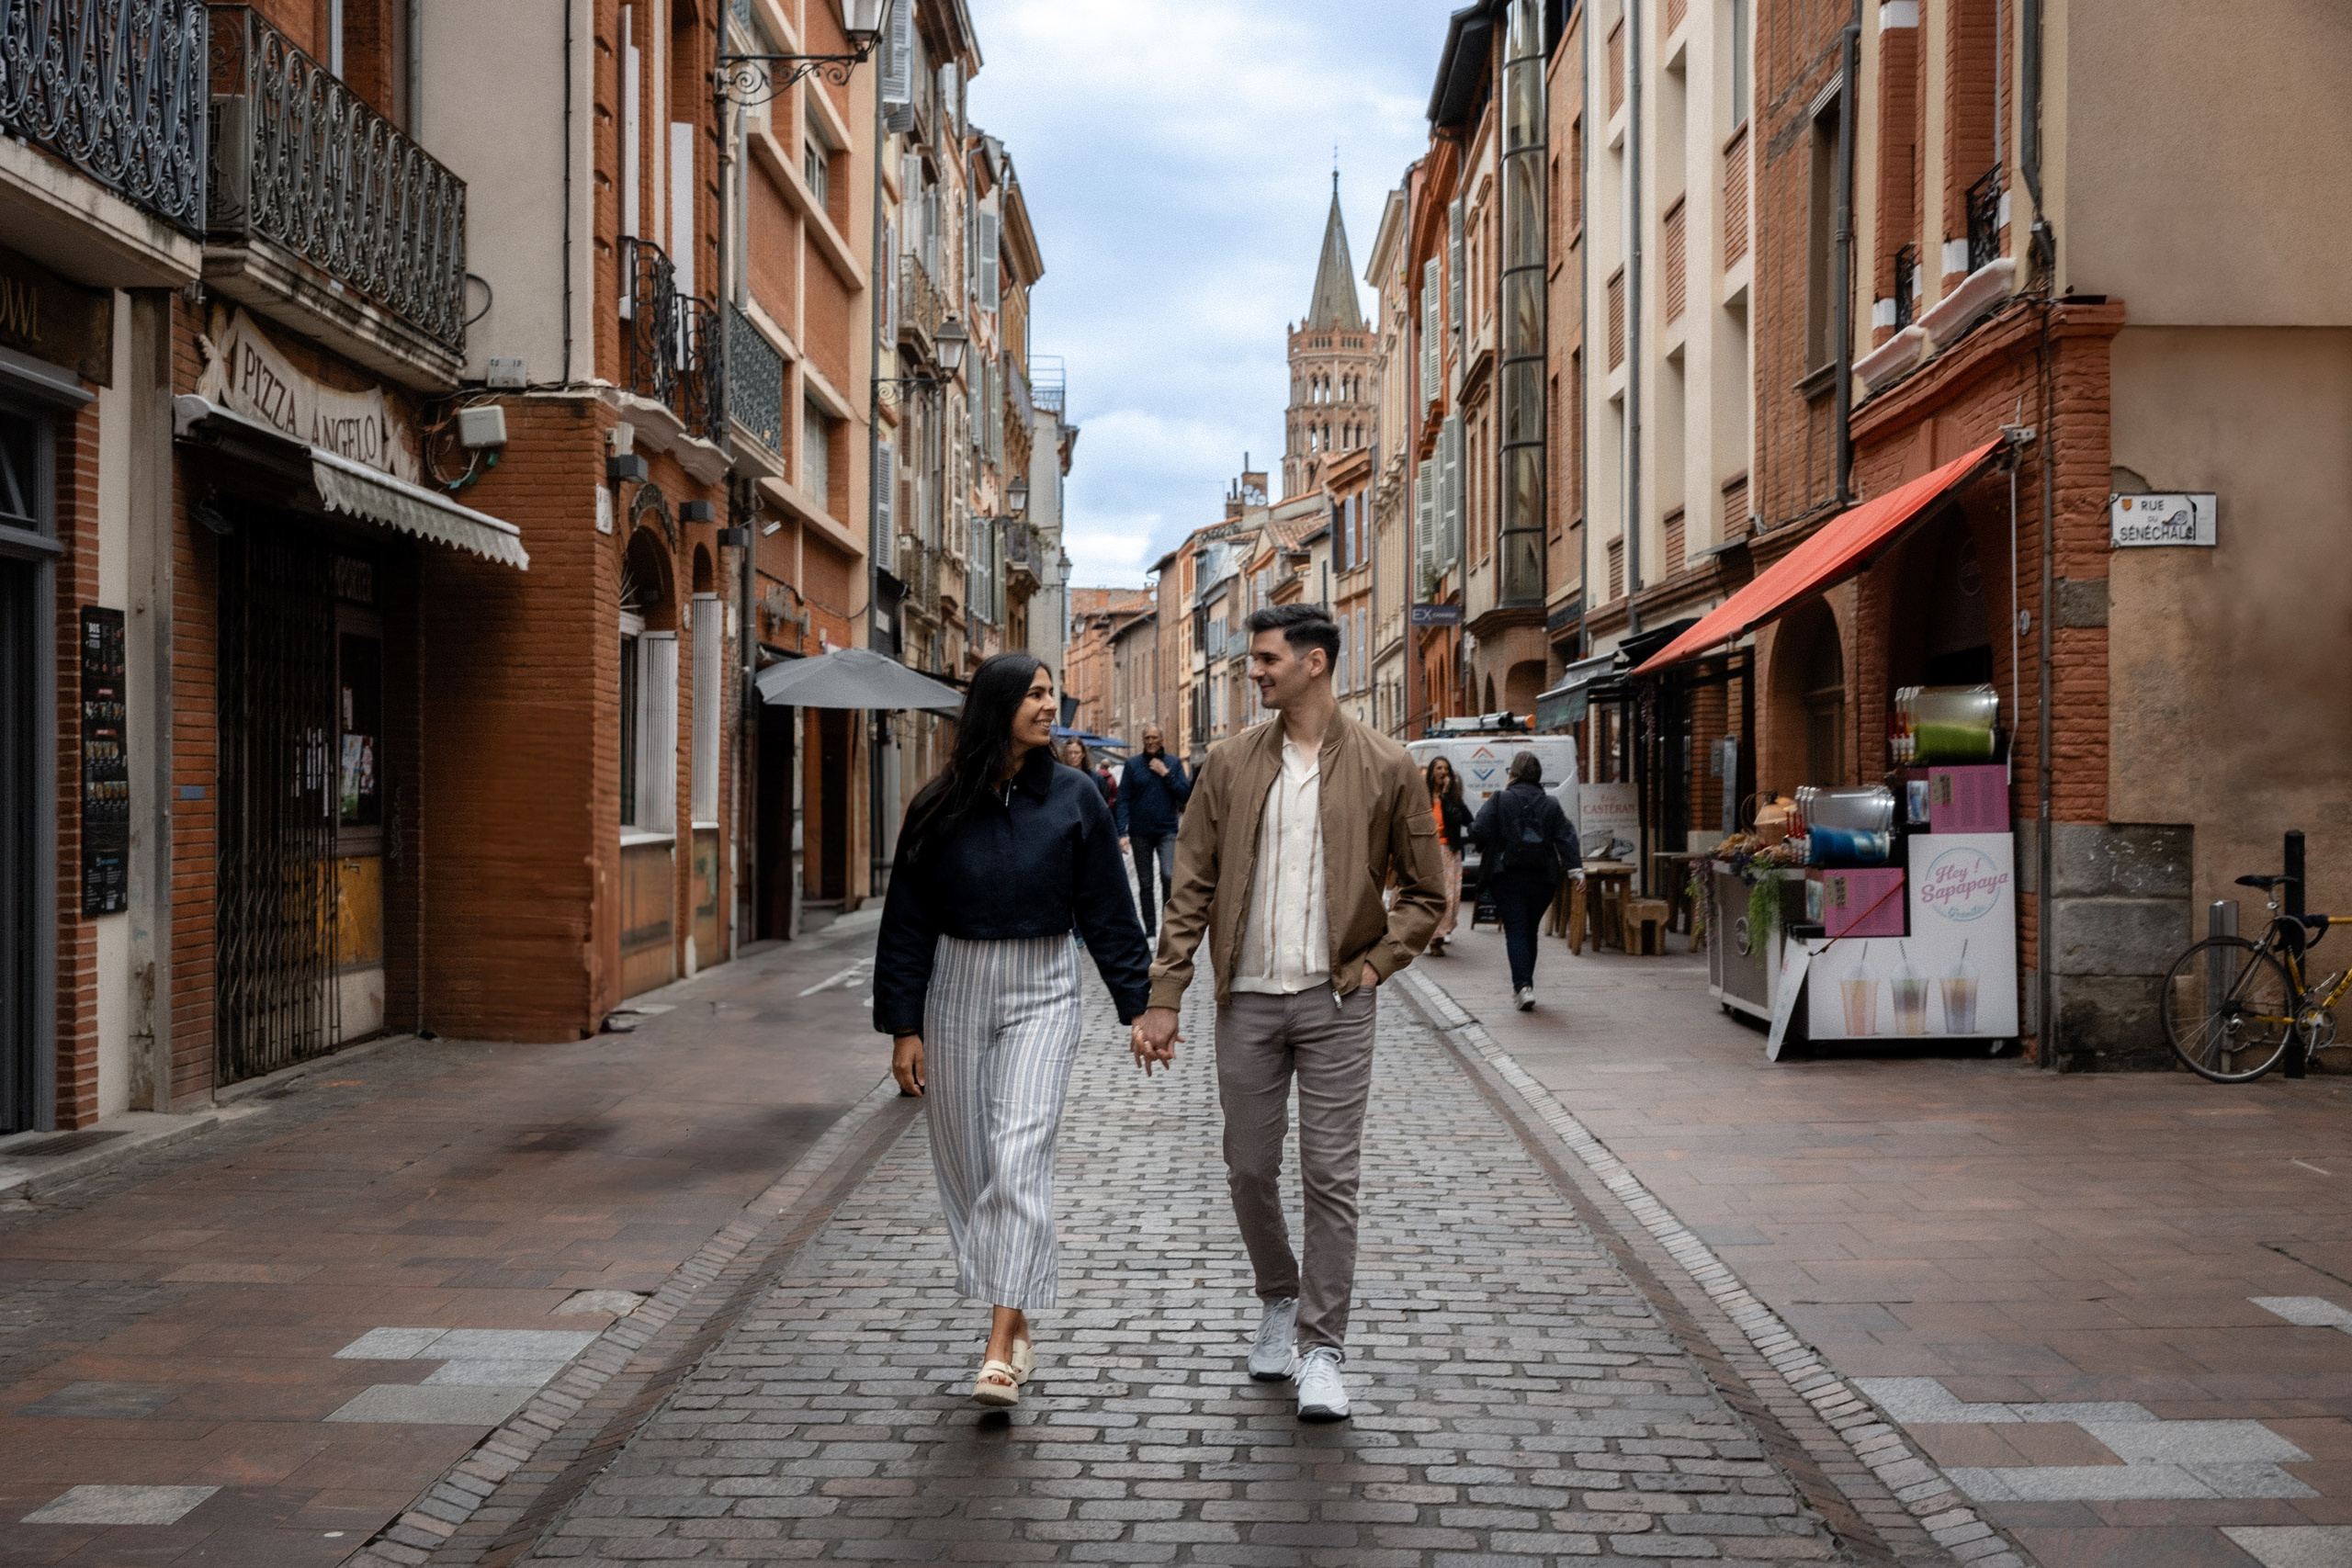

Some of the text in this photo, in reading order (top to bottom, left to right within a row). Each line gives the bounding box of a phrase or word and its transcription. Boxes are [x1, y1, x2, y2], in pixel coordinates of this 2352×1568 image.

[242, 342, 377, 462] PIZZA ANGELO
[2142, 501, 2165, 512] RUE
[1412, 608, 1432, 621] EX
[1935, 864, 1968, 885] Hey
[1921, 872, 2009, 905] Sapapaya
